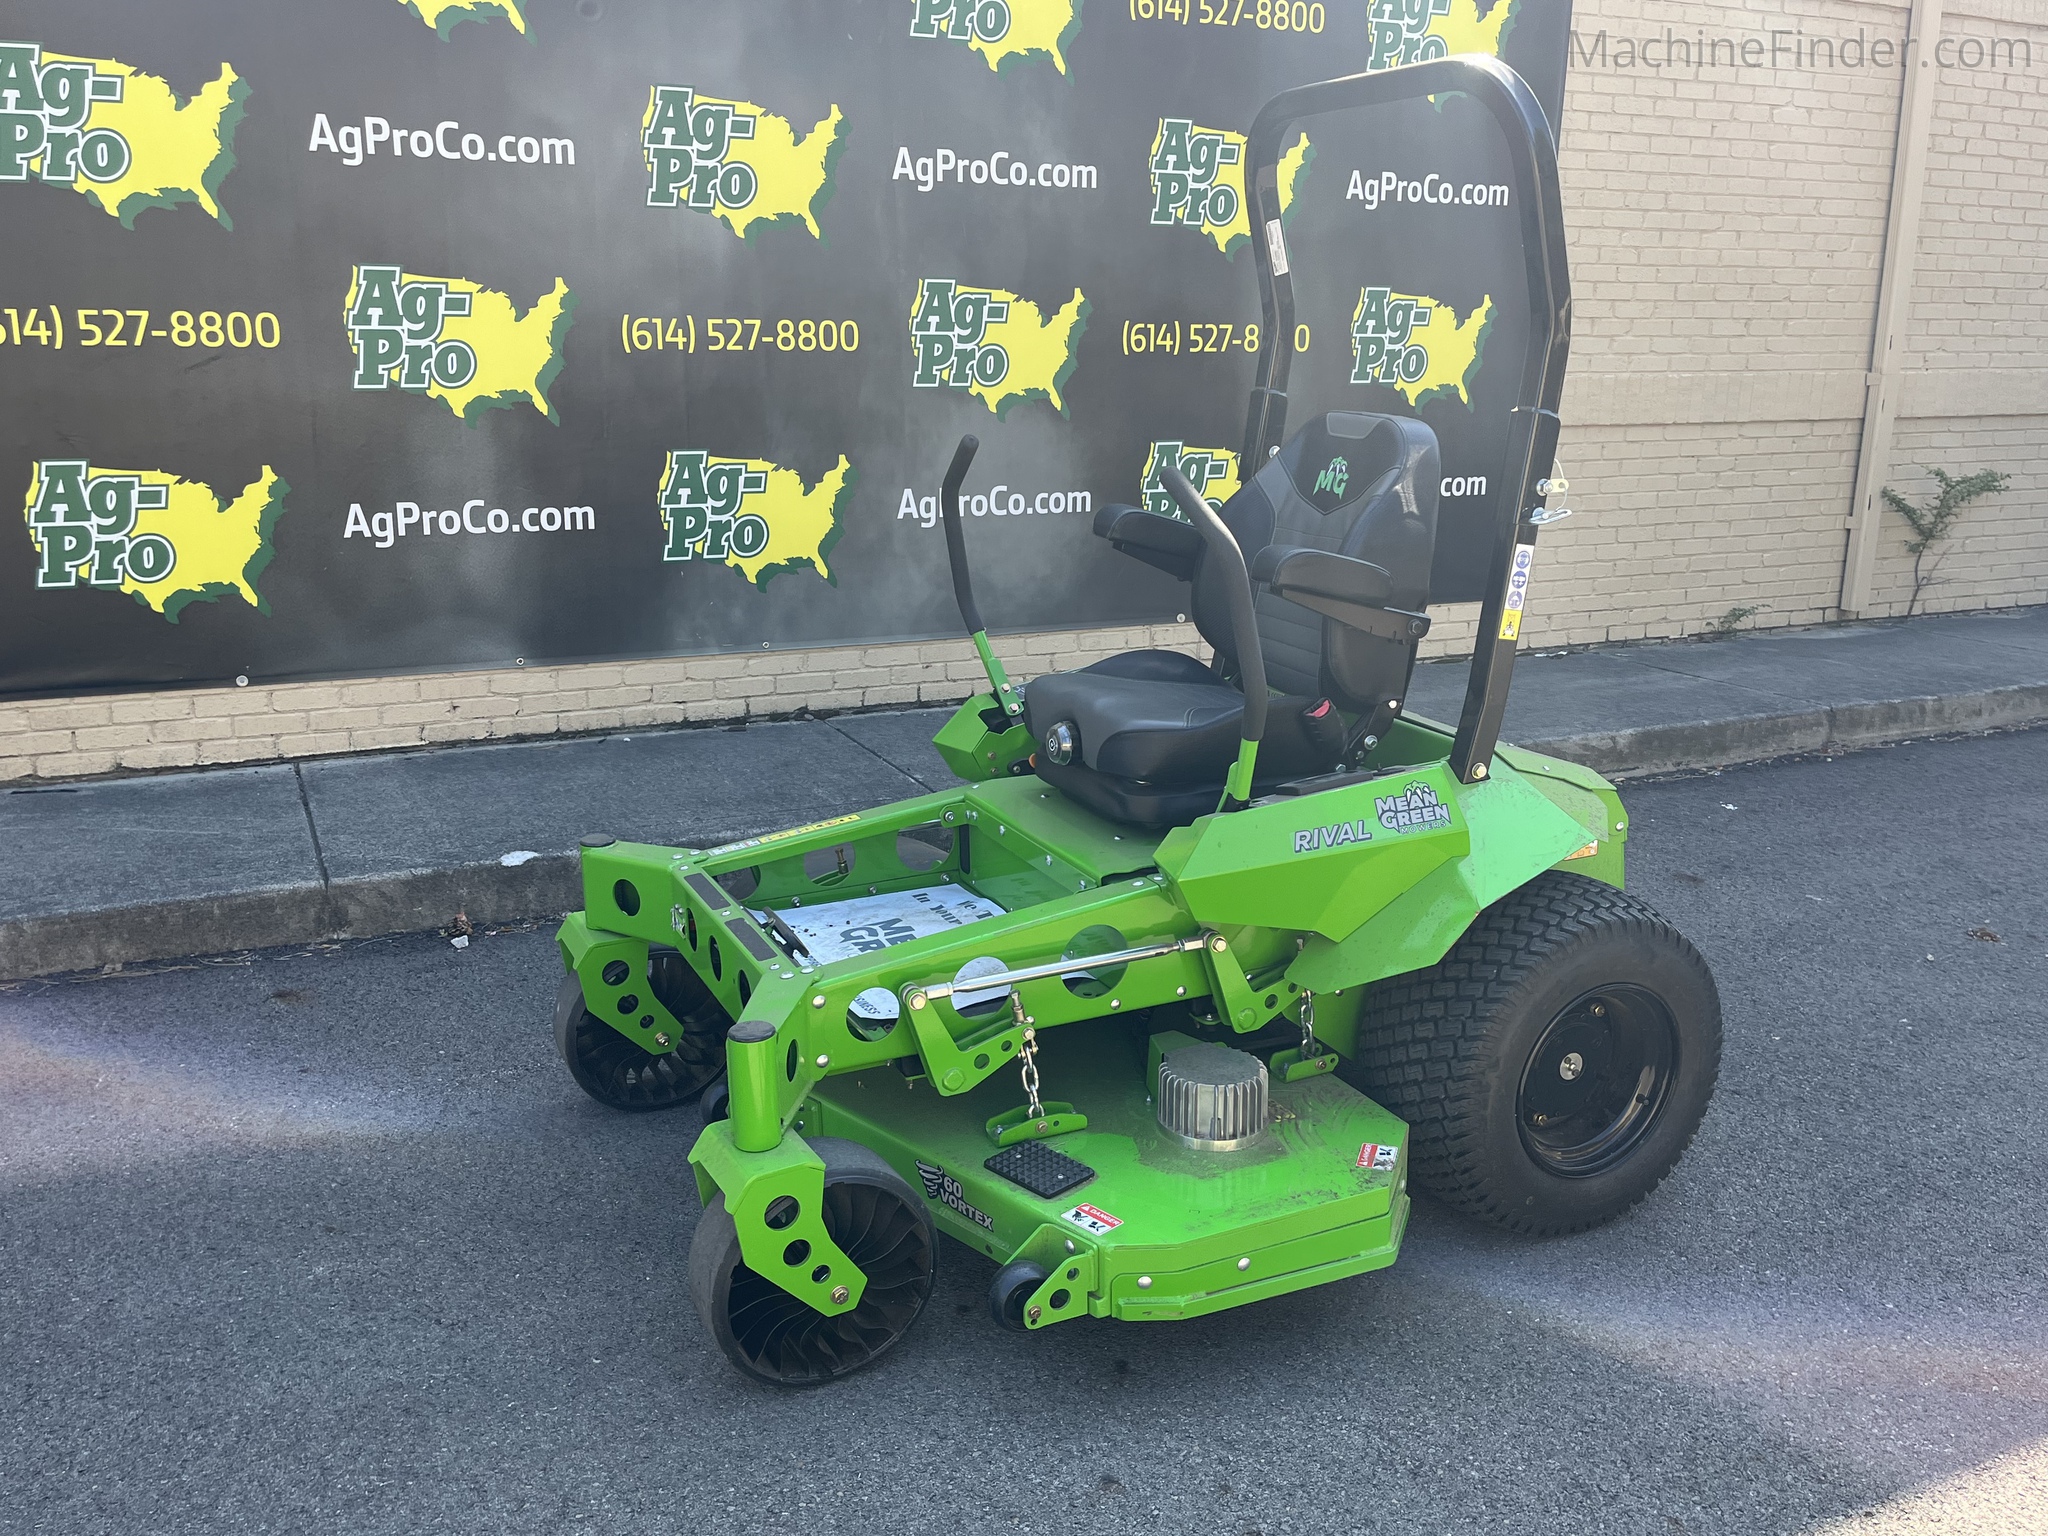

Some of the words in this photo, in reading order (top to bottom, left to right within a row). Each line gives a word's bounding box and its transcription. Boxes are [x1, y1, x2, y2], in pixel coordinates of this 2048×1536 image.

[1200, 0, 1325, 33] 527-8800
[1367, 21, 1448, 72] Pro
[0, 43, 122, 131] Ag-
[0, 112, 129, 181] Pro
[309, 113, 576, 166] AgProCo.com
[644, 86, 755, 162] Ag-
[892, 146, 1097, 192] AgProCo.com
[1151, 118, 1239, 186] Ag-
[647, 147, 757, 207] Pro
[1151, 172, 1237, 225] Pro
[1345, 169, 1509, 210] AgProCo.com
[77, 309, 281, 348] 527-8800
[348, 266, 470, 342] Ag-
[912, 279, 1008, 347] Ag-
[1353, 287, 1430, 347] Ag-
[354, 328, 475, 388] Pro
[621, 314, 696, 353] (614)
[707, 318, 859, 352] 527-8800
[1123, 321, 1181, 355] (614)
[1189, 323, 1311, 353] 527-80
[913, 334, 1008, 387] Pro
[1350, 335, 1427, 383] Pro
[30, 461, 166, 538] Ag-
[661, 451, 766, 519] Ag-
[896, 485, 1092, 528] AgroCo.com
[1312, 469, 1349, 500] MG
[343, 499, 595, 548] AgProCo.com
[664, 506, 768, 560] Pro
[38, 525, 174, 587] Pro
[1375, 790, 1438, 823] MEAN
[1379, 803, 1452, 834] GREEN
[1401, 820, 1446, 835] MOWERS
[1294, 819, 1373, 853] RIVAL
[929, 904, 963, 925] Your
[940, 1188, 995, 1233] VORTEX
[943, 1176, 963, 1199] 60
[1089, 1208, 1121, 1226] DANGER
